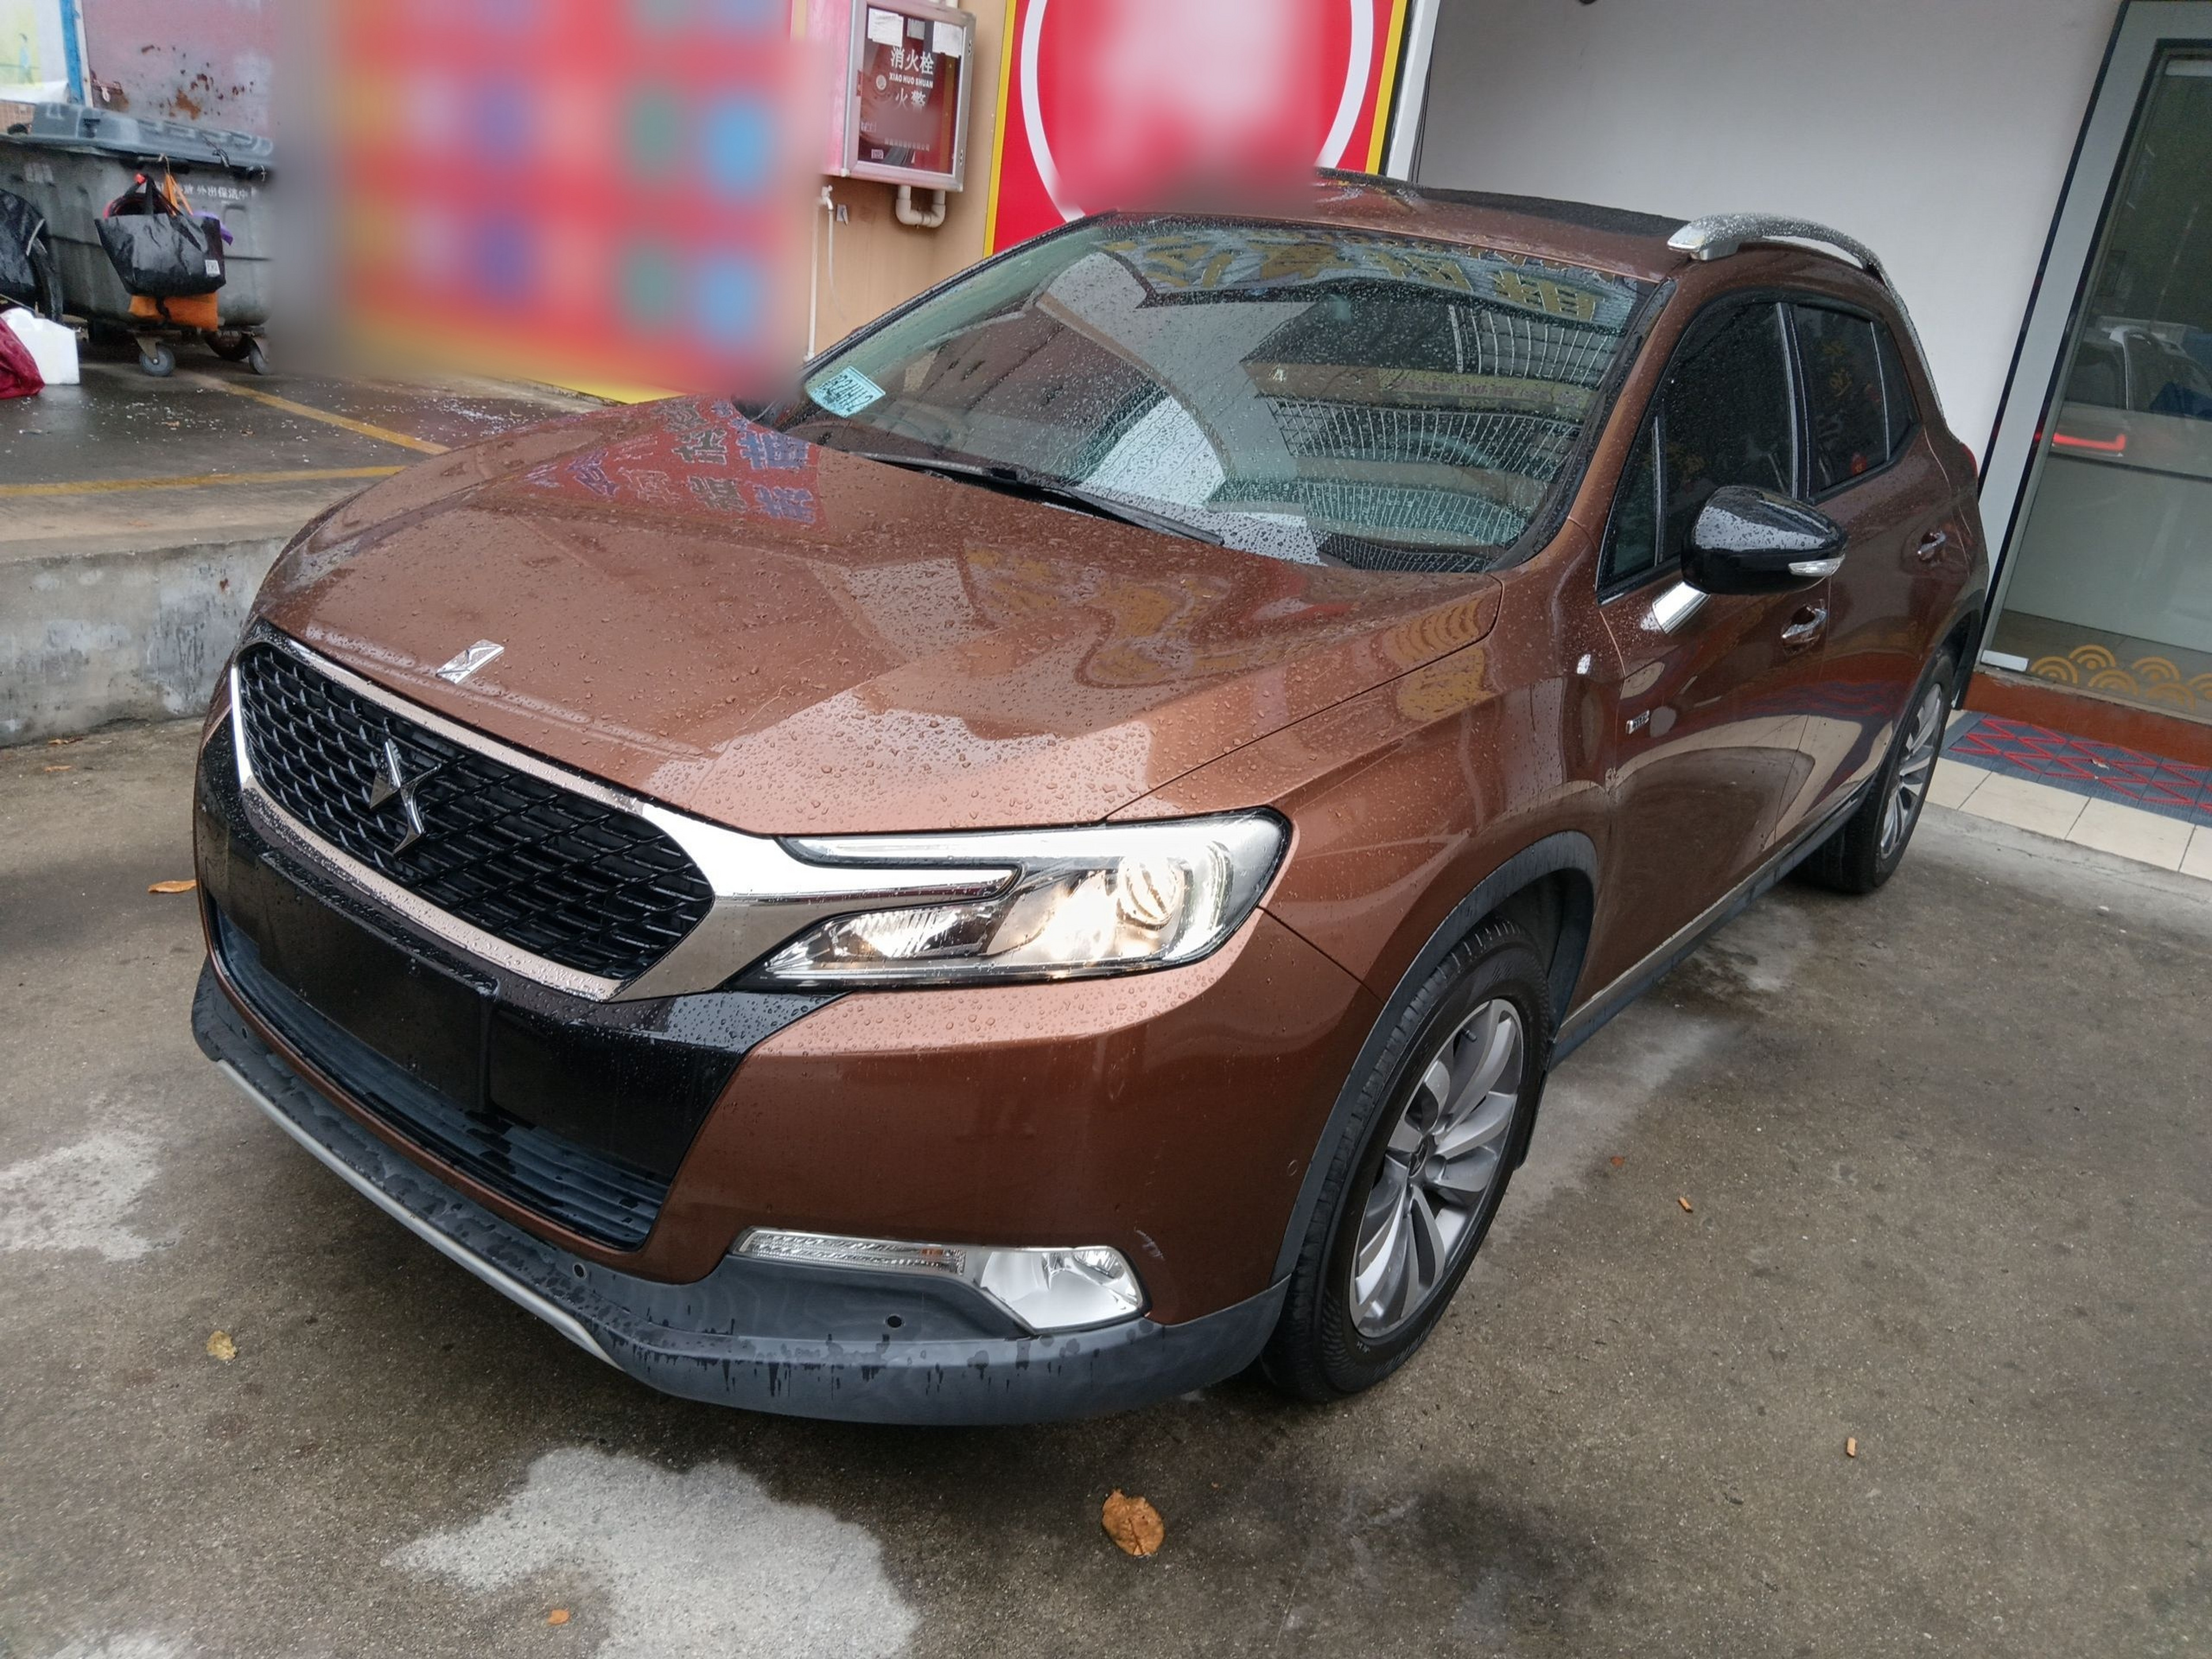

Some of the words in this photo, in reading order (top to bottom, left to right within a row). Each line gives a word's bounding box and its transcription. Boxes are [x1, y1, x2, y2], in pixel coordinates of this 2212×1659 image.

[891, 46, 934, 75] 消火栓
[889, 72, 902, 82] XIAO
[903, 74, 915, 85] HUO
[915, 78, 933, 89] SHUAN
